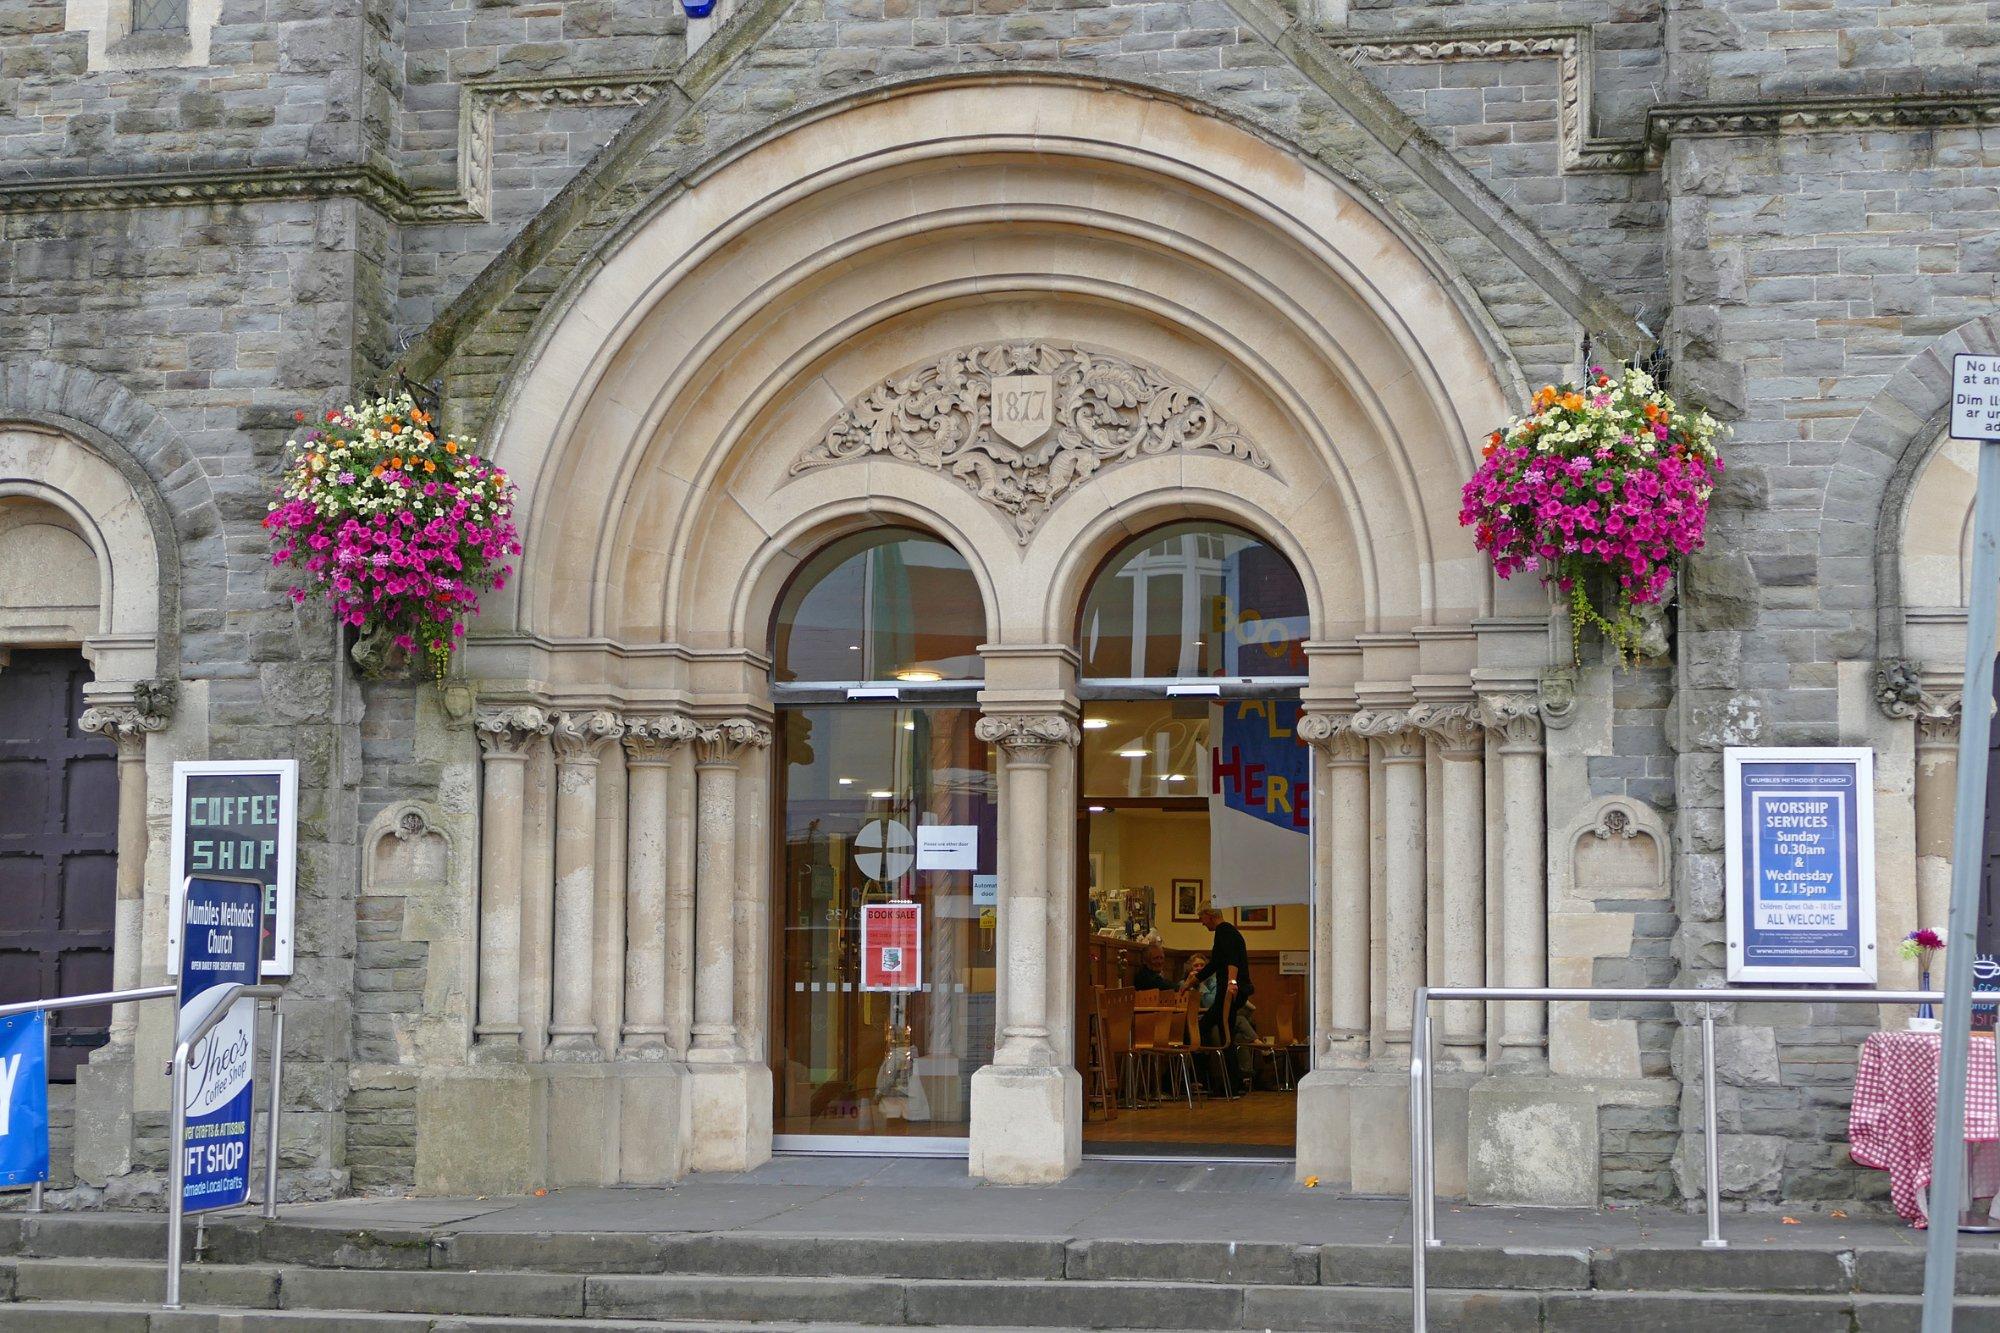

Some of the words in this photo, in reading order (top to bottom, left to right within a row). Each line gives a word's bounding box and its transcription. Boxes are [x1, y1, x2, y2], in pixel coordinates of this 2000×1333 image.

[1966, 360, 1986, 372] No
[1963, 373, 1977, 384] at
[997, 390, 1047, 422] 1877
[1956, 393, 1983, 405] Dim
[1990, 395, 2000, 406] ll
[1966, 409, 1980, 418] ar
[1213, 745, 1309, 827] HERE
[190, 795, 278, 825] COFFEE
[1765, 802, 1829, 813] WORSHIP
[1766, 816, 1828, 828] SERVICES
[1777, 830, 1820, 844] Sunday
[193, 840, 275, 870] SHOP
[1774, 843, 1826, 855] 10.30am
[1794, 856, 1805, 868] &
[1765, 869, 1834, 883] Wednesday
[1774, 882, 1827, 896] 12.15pm
[186, 900, 220, 926] Mumbles
[220, 901, 255, 928] Methodist
[868, 910, 893, 919] BOOK
[896, 910, 915, 919] SALE
[1766, 913, 1784, 925] ALL
[1787, 913, 1836, 925] WELCOME
[207, 928, 233, 954] Church
[1756, 947, 1849, 956] www.mumblesmethodist.org
[205, 1077, 227, 1106] Coffee
[229, 1060, 247, 1085] Shop
[184, 1145, 205, 1177] IFT
[206, 1141, 244, 1173] SHOP
[206, 1178, 223, 1193] Local
[223, 1176, 243, 1191] Crafts
